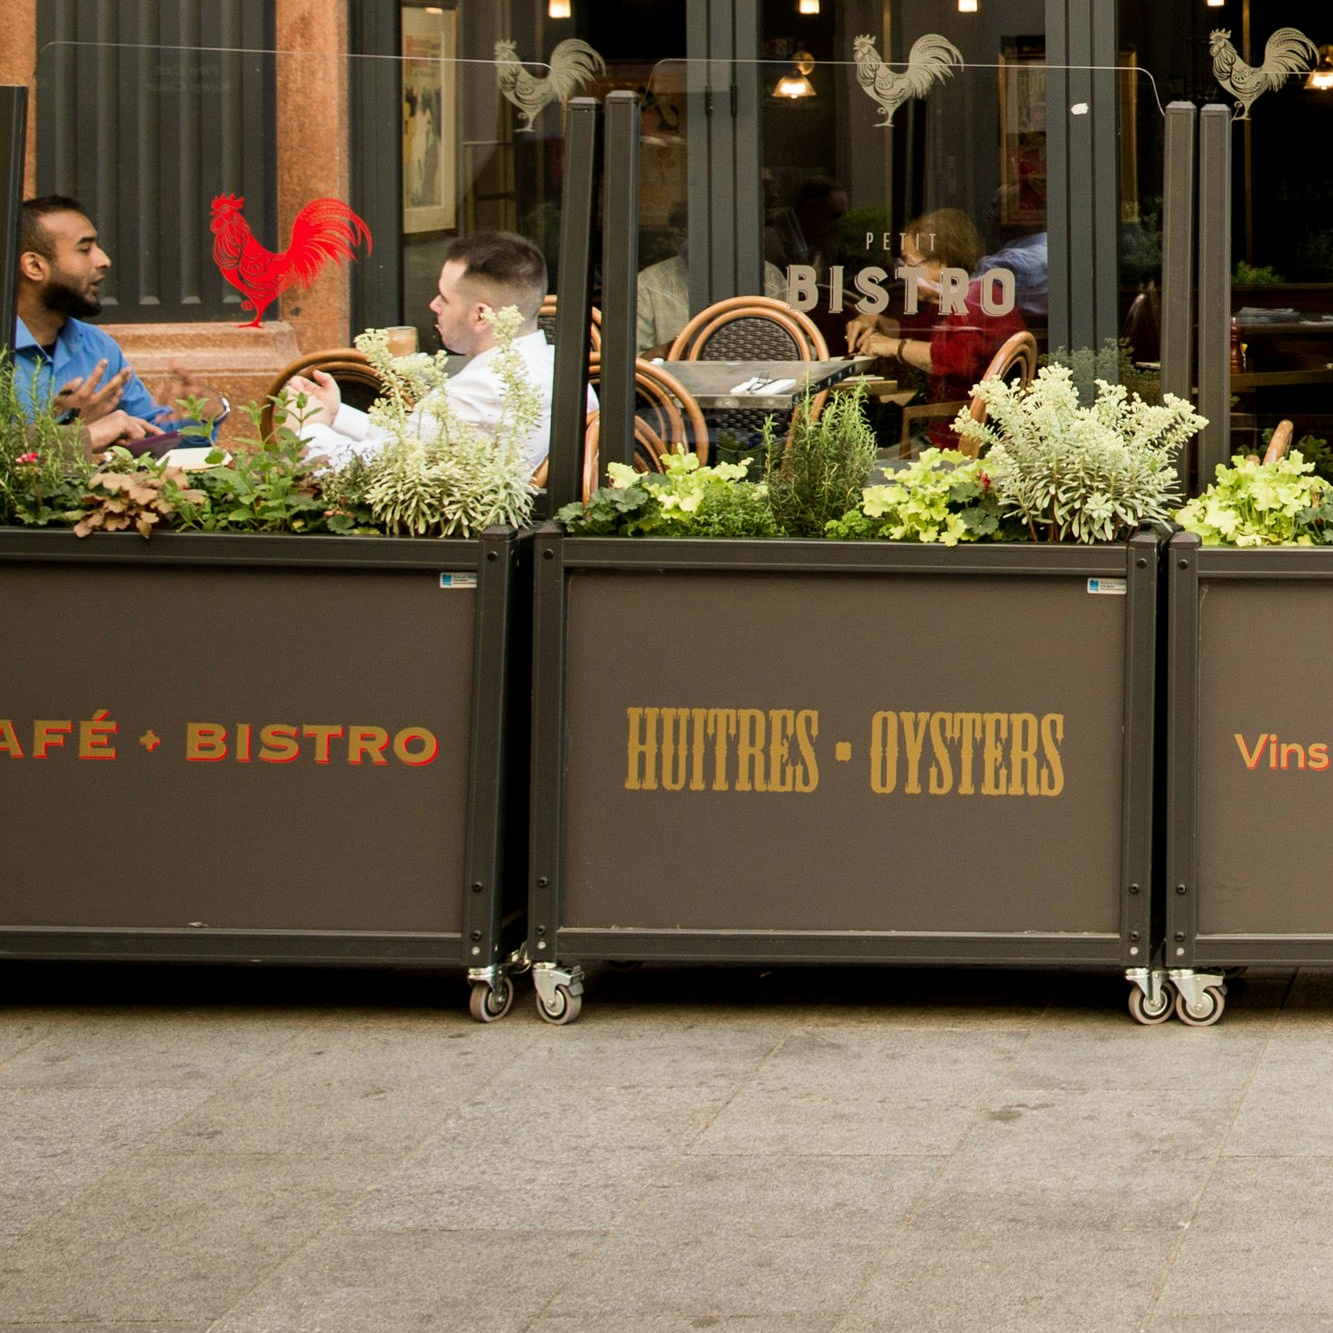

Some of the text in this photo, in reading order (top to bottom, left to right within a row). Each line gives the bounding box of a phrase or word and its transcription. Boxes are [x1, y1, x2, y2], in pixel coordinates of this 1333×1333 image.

[865, 232, 937, 251] PETIT
[786, 264, 1016, 316] BISTRO
[185, 722, 440, 766] BISTRO
[624, 707, 1065, 797] HUITRES OYSTERS
[1234, 733, 1330, 772] Vins
